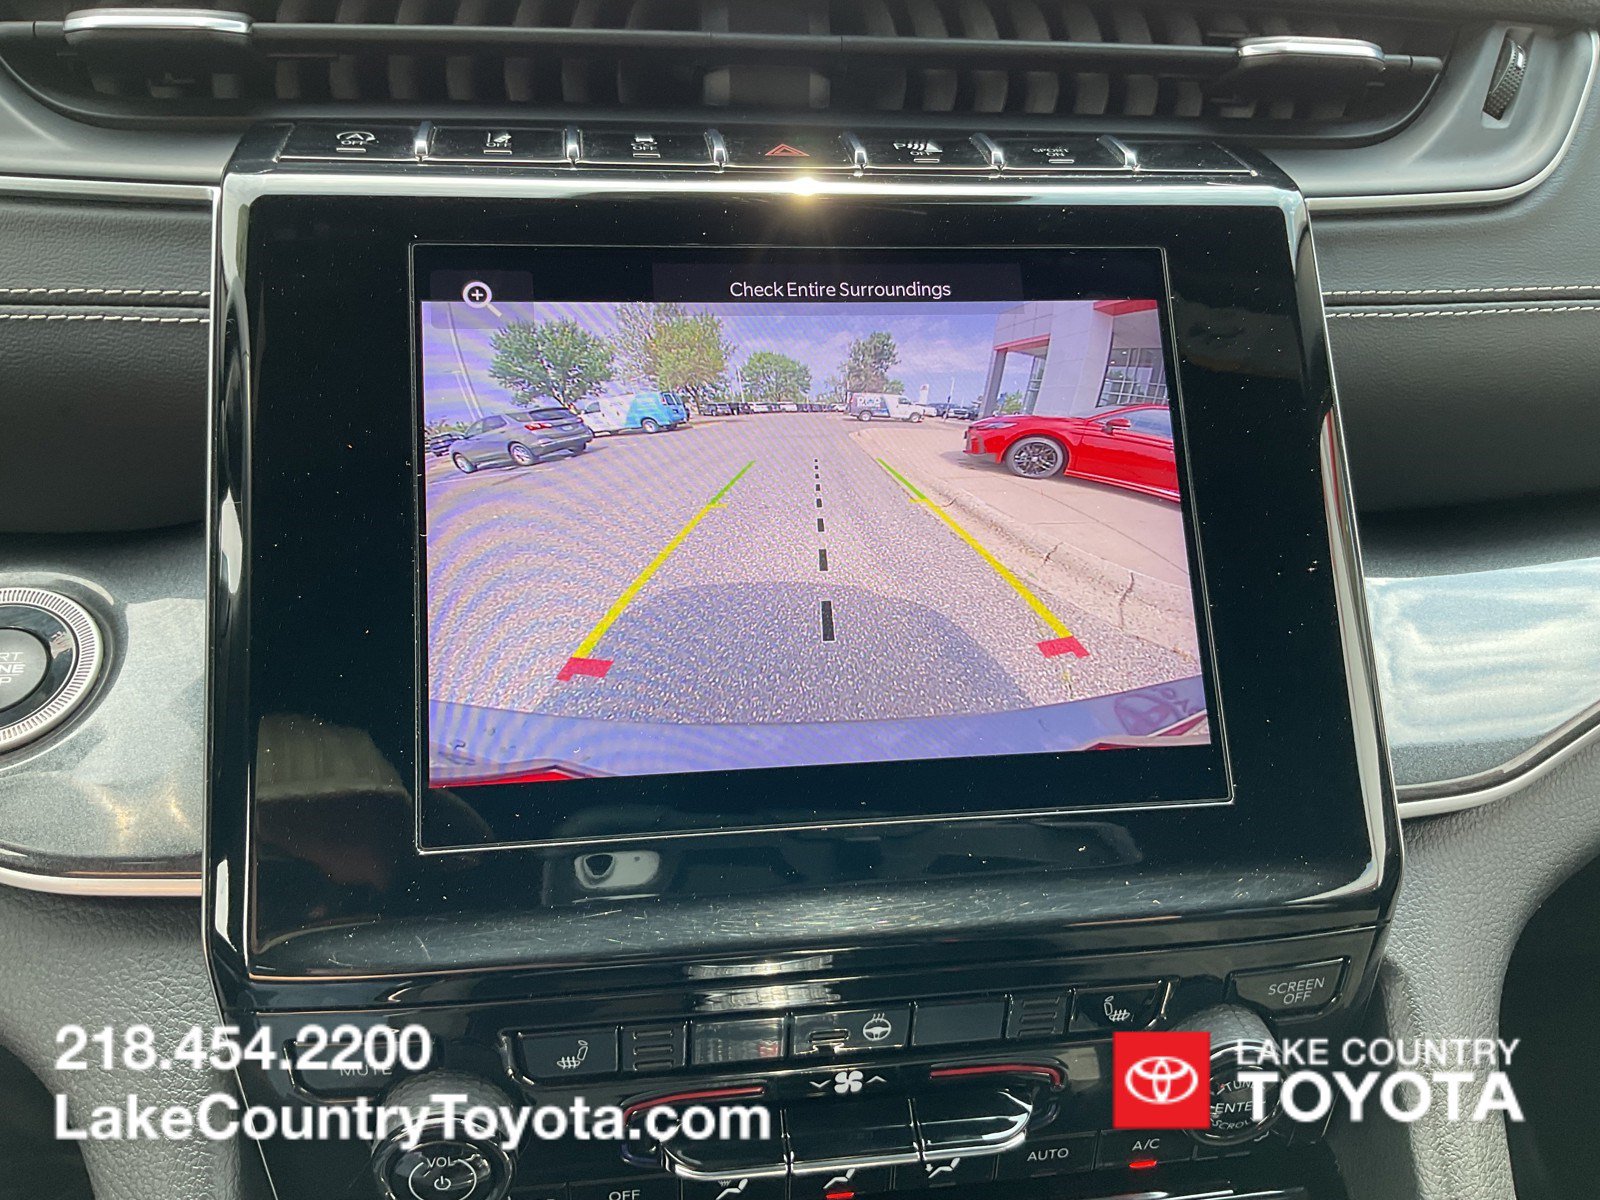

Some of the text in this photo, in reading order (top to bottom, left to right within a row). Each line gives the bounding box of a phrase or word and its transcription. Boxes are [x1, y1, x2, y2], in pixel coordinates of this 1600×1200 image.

[730, 281, 951, 300] Check Entire Surroundings
[1268, 976, 1326, 996] SCREEN
[1283, 991, 1312, 1005] OFF
[1215, 1099, 1257, 1114] ENTE
[1131, 1138, 1160, 1152] A/C
[1027, 1147, 1069, 1162] AUTO
[427, 1156, 456, 1168] VOL
[608, 1189, 641, 1200] OFF
